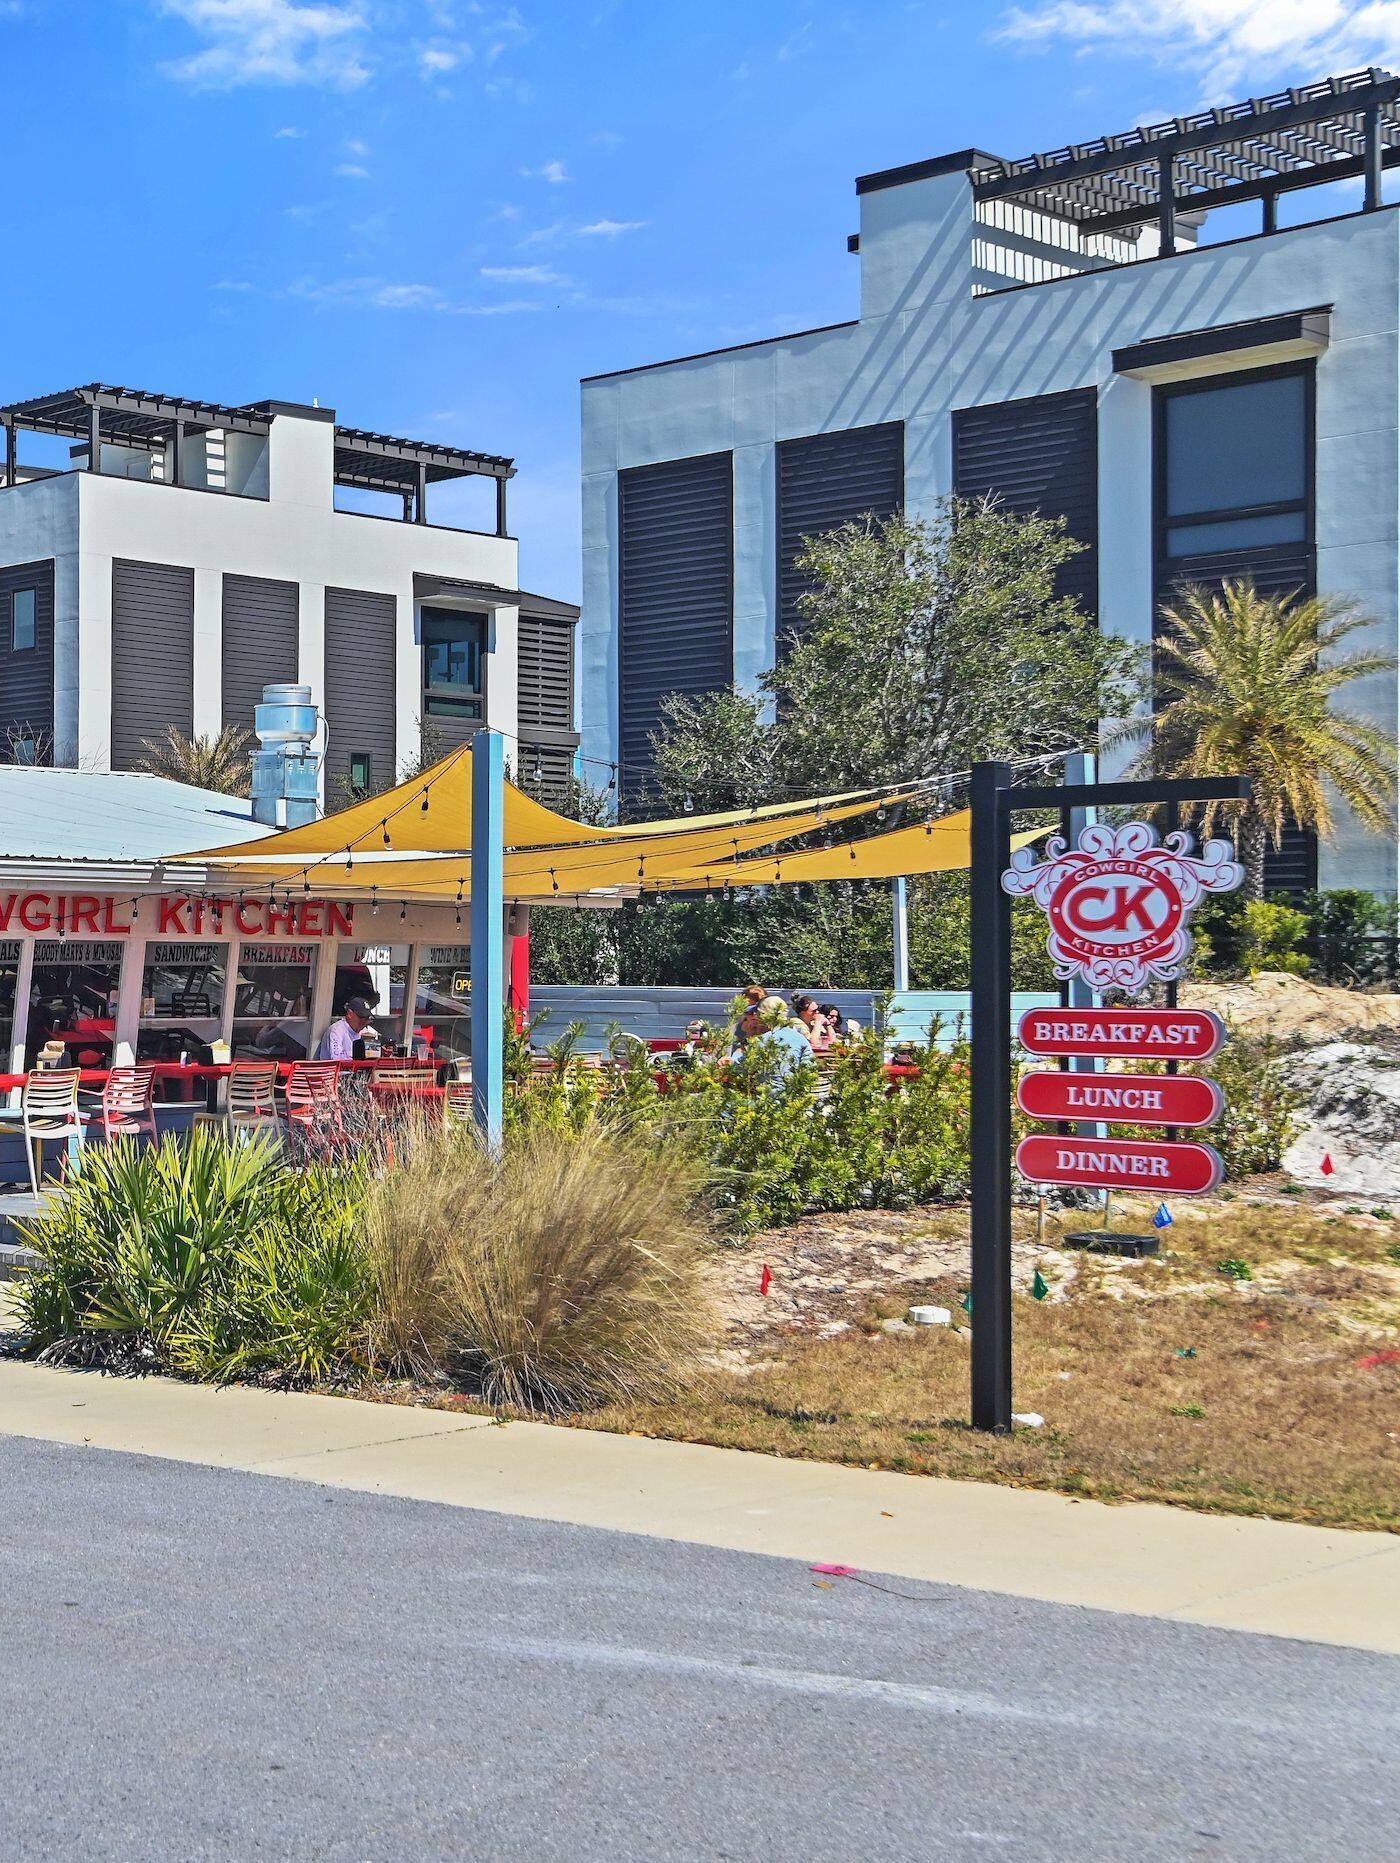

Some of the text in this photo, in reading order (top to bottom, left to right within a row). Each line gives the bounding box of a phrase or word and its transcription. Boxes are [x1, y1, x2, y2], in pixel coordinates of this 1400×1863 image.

[1074, 861, 1160, 883] COWGIRL
[158, 897, 355, 937] KITCHEN
[1066, 885, 1158, 932] CK
[243, 946, 313, 964] BREAKFAST
[354, 946, 392, 964] LUNCH
[1071, 935, 1161, 957] KITCHEN
[455, 979, 472, 991] OPE
[1034, 1022, 1200, 1044] BREAKFAST
[1066, 1087, 1162, 1110] LUNCH
[1056, 1150, 1170, 1178] DINNER
